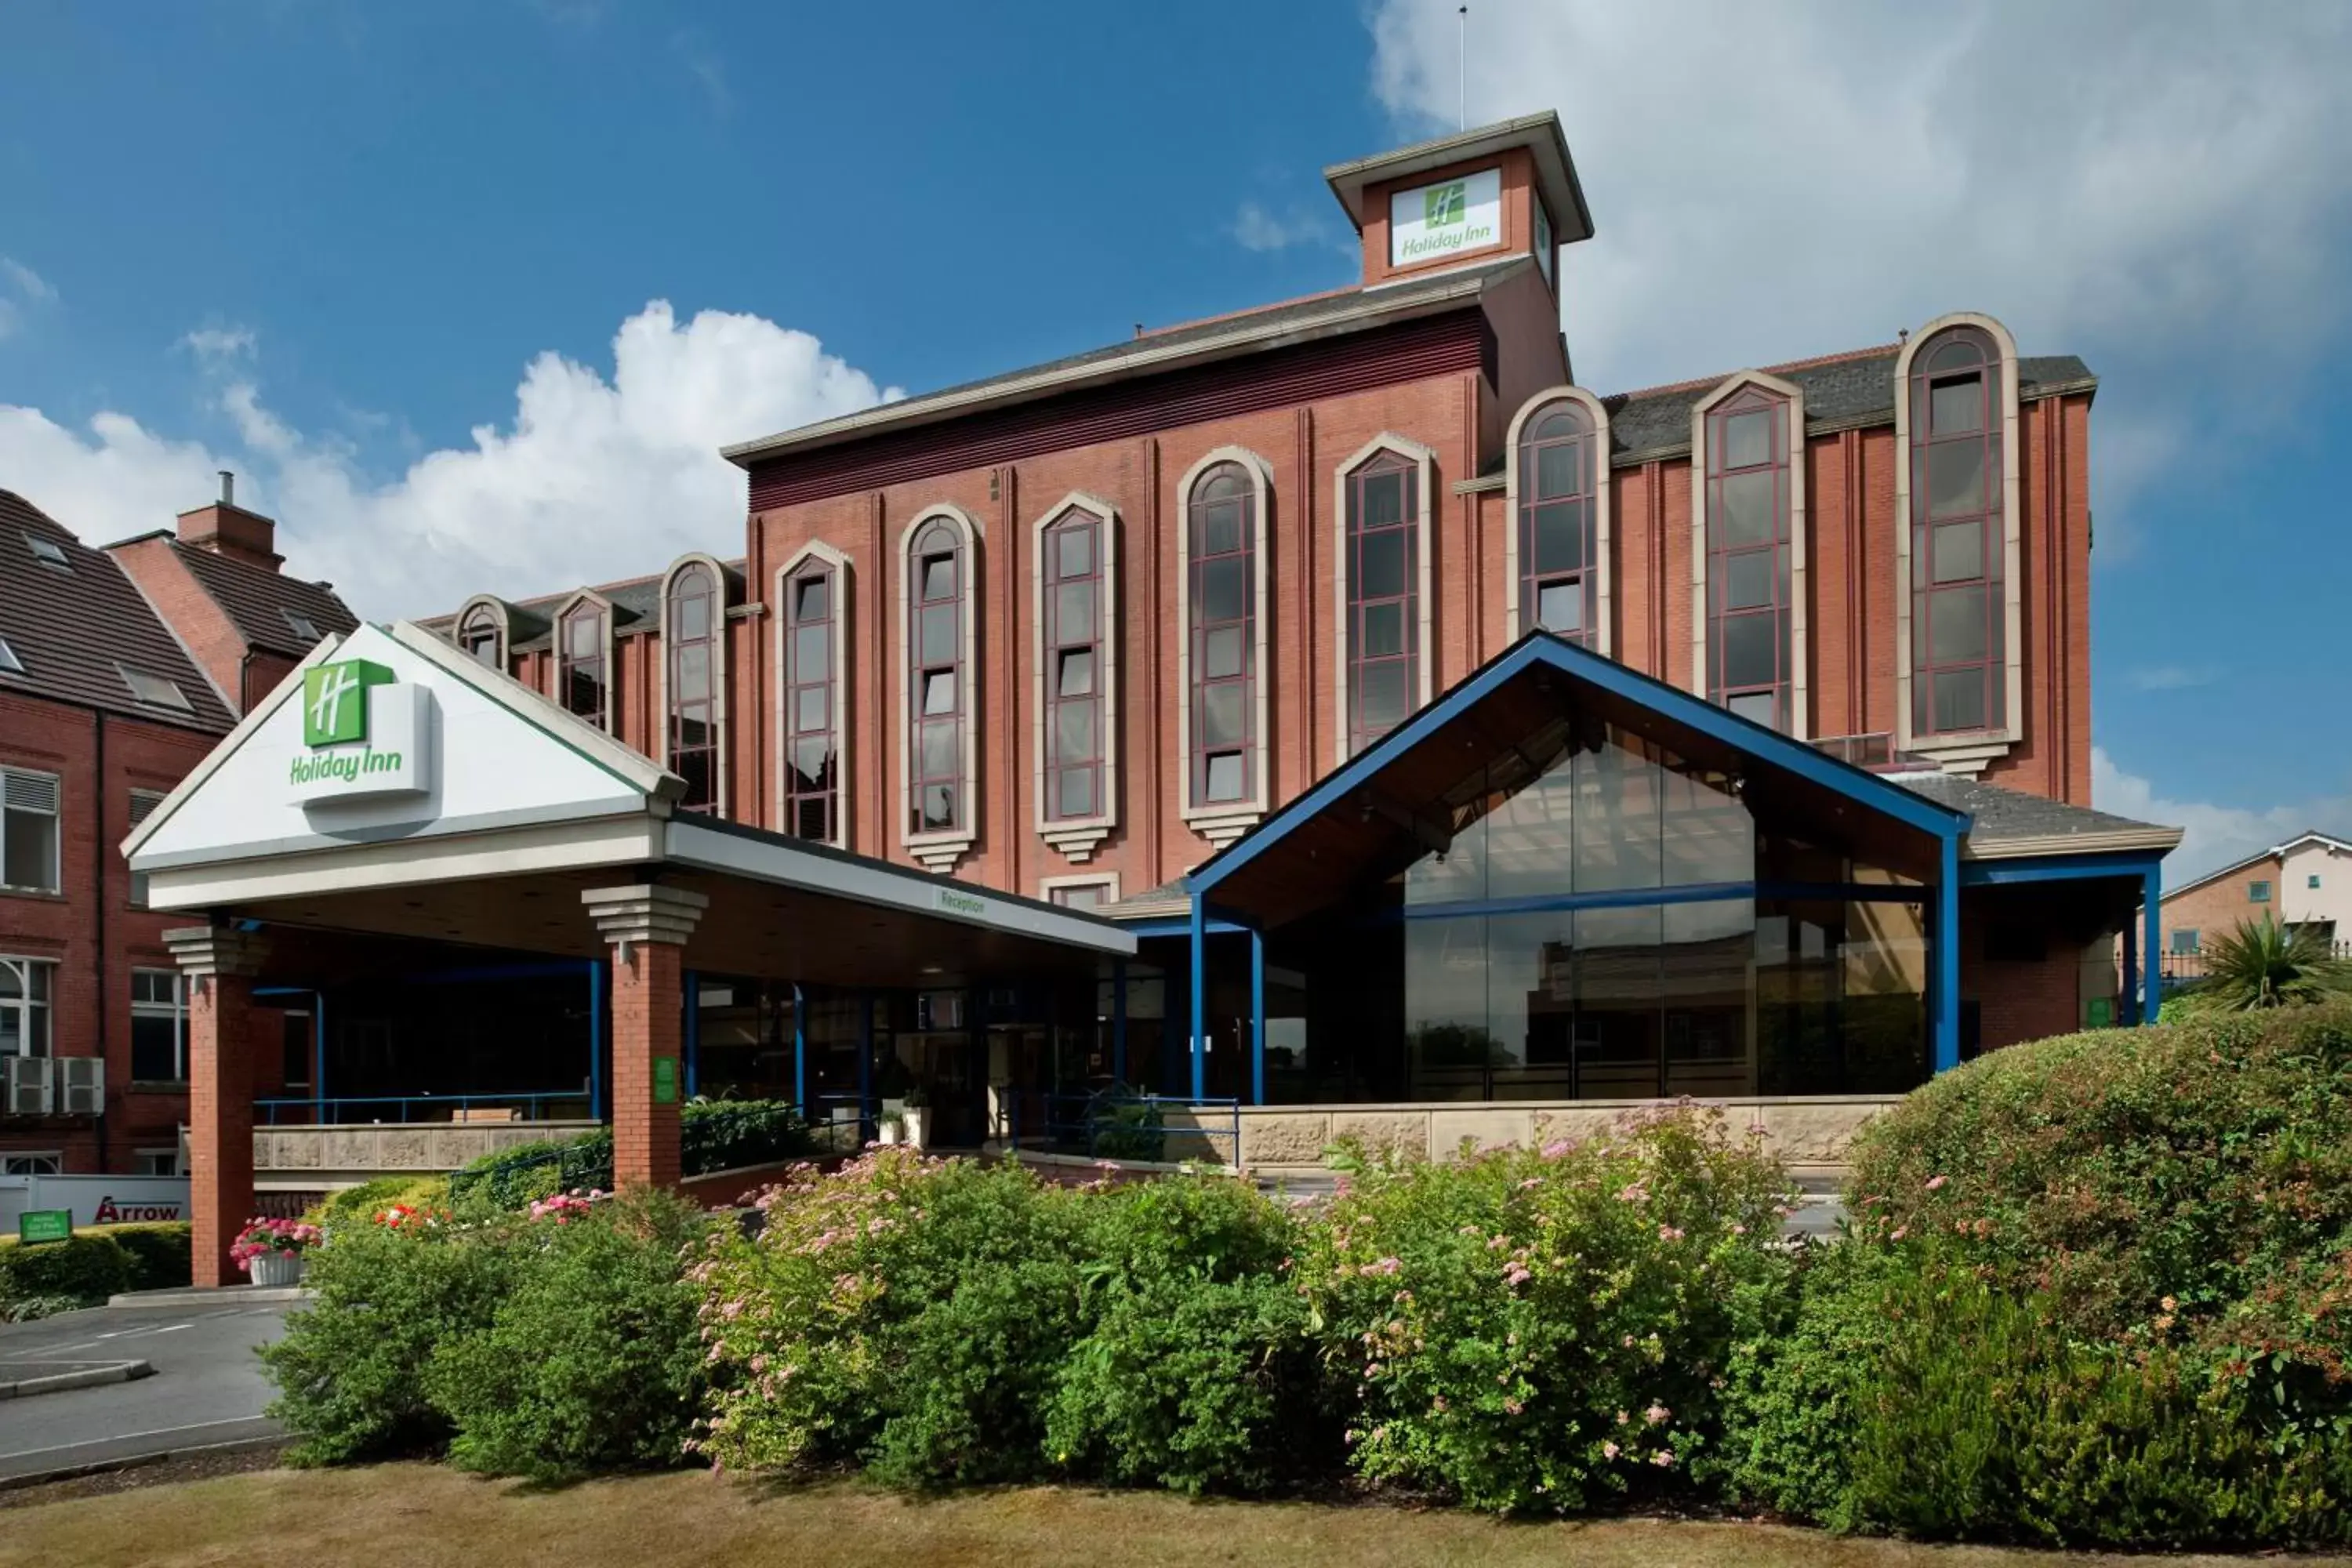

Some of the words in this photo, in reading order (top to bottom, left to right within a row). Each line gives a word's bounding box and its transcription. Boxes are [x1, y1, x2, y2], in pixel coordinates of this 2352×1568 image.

[1403, 232, 1462, 257] Holiday
[1465, 224, 1491, 241] Inn
[290, 750, 360, 785] Holiday
[363, 746, 402, 774] Inn
[942, 891, 985, 916] Reception
[96, 1196, 180, 1221] Arrow
